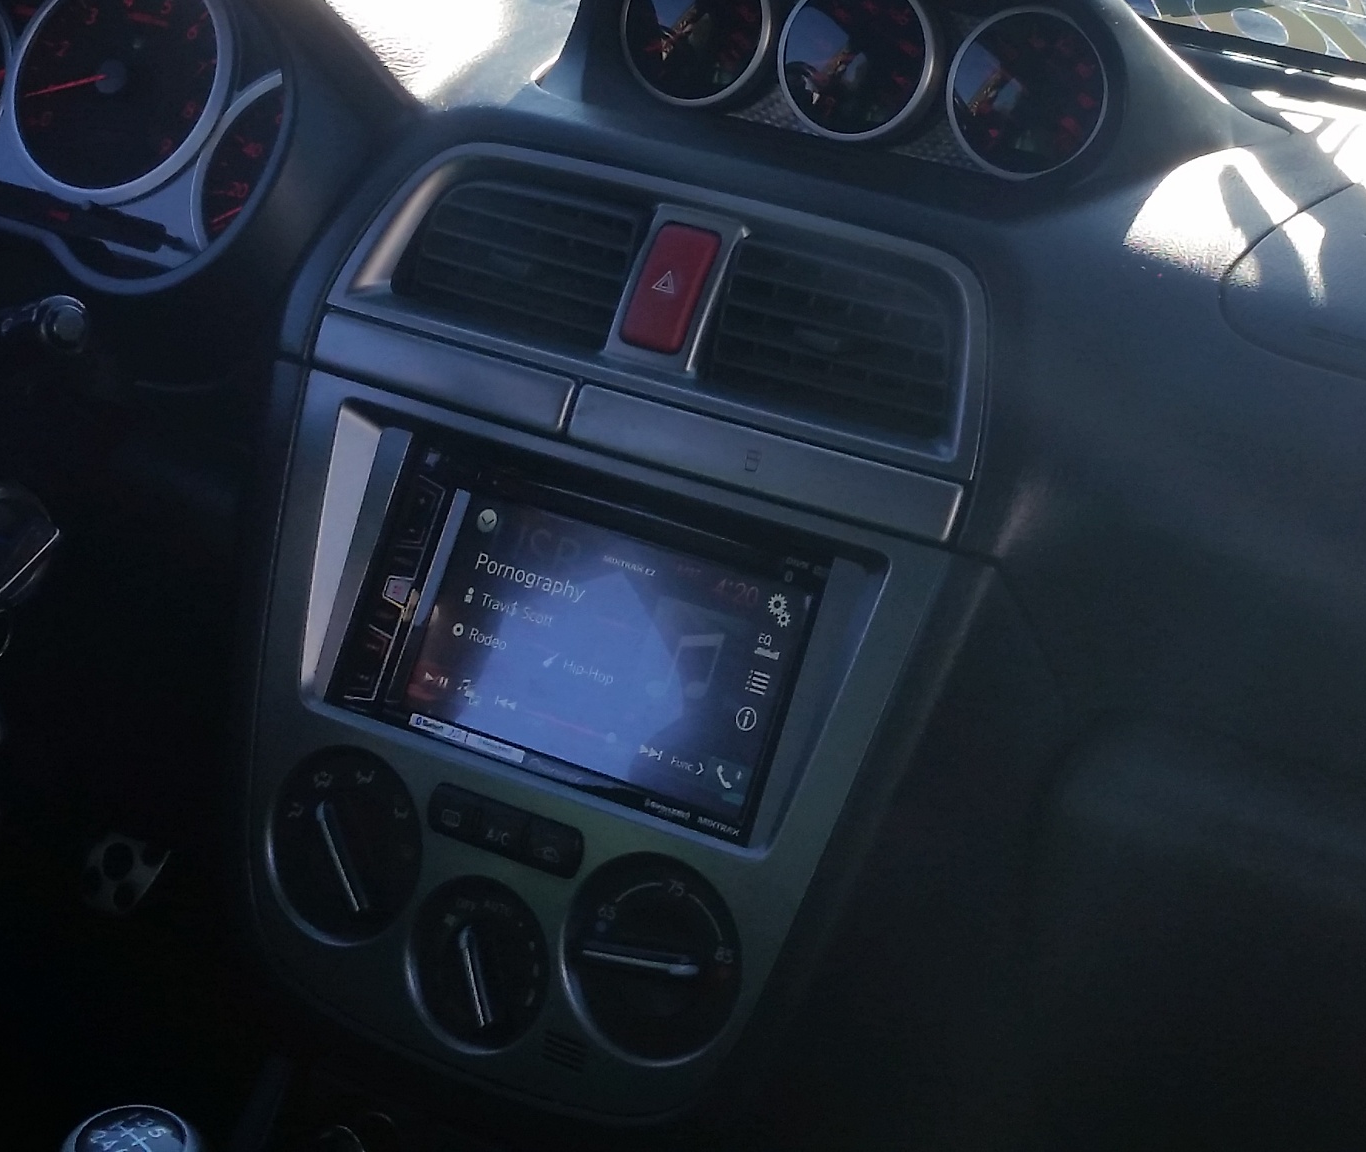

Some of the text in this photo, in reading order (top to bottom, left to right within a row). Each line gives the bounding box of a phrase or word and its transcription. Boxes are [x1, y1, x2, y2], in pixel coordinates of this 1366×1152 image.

[474, 553, 586, 603] Pornography
[522, 606, 554, 628] Scott
[469, 628, 507, 650] Rodeo
[757, 632, 772, 647] EQ
[563, 659, 614, 686] Hip-Hop
